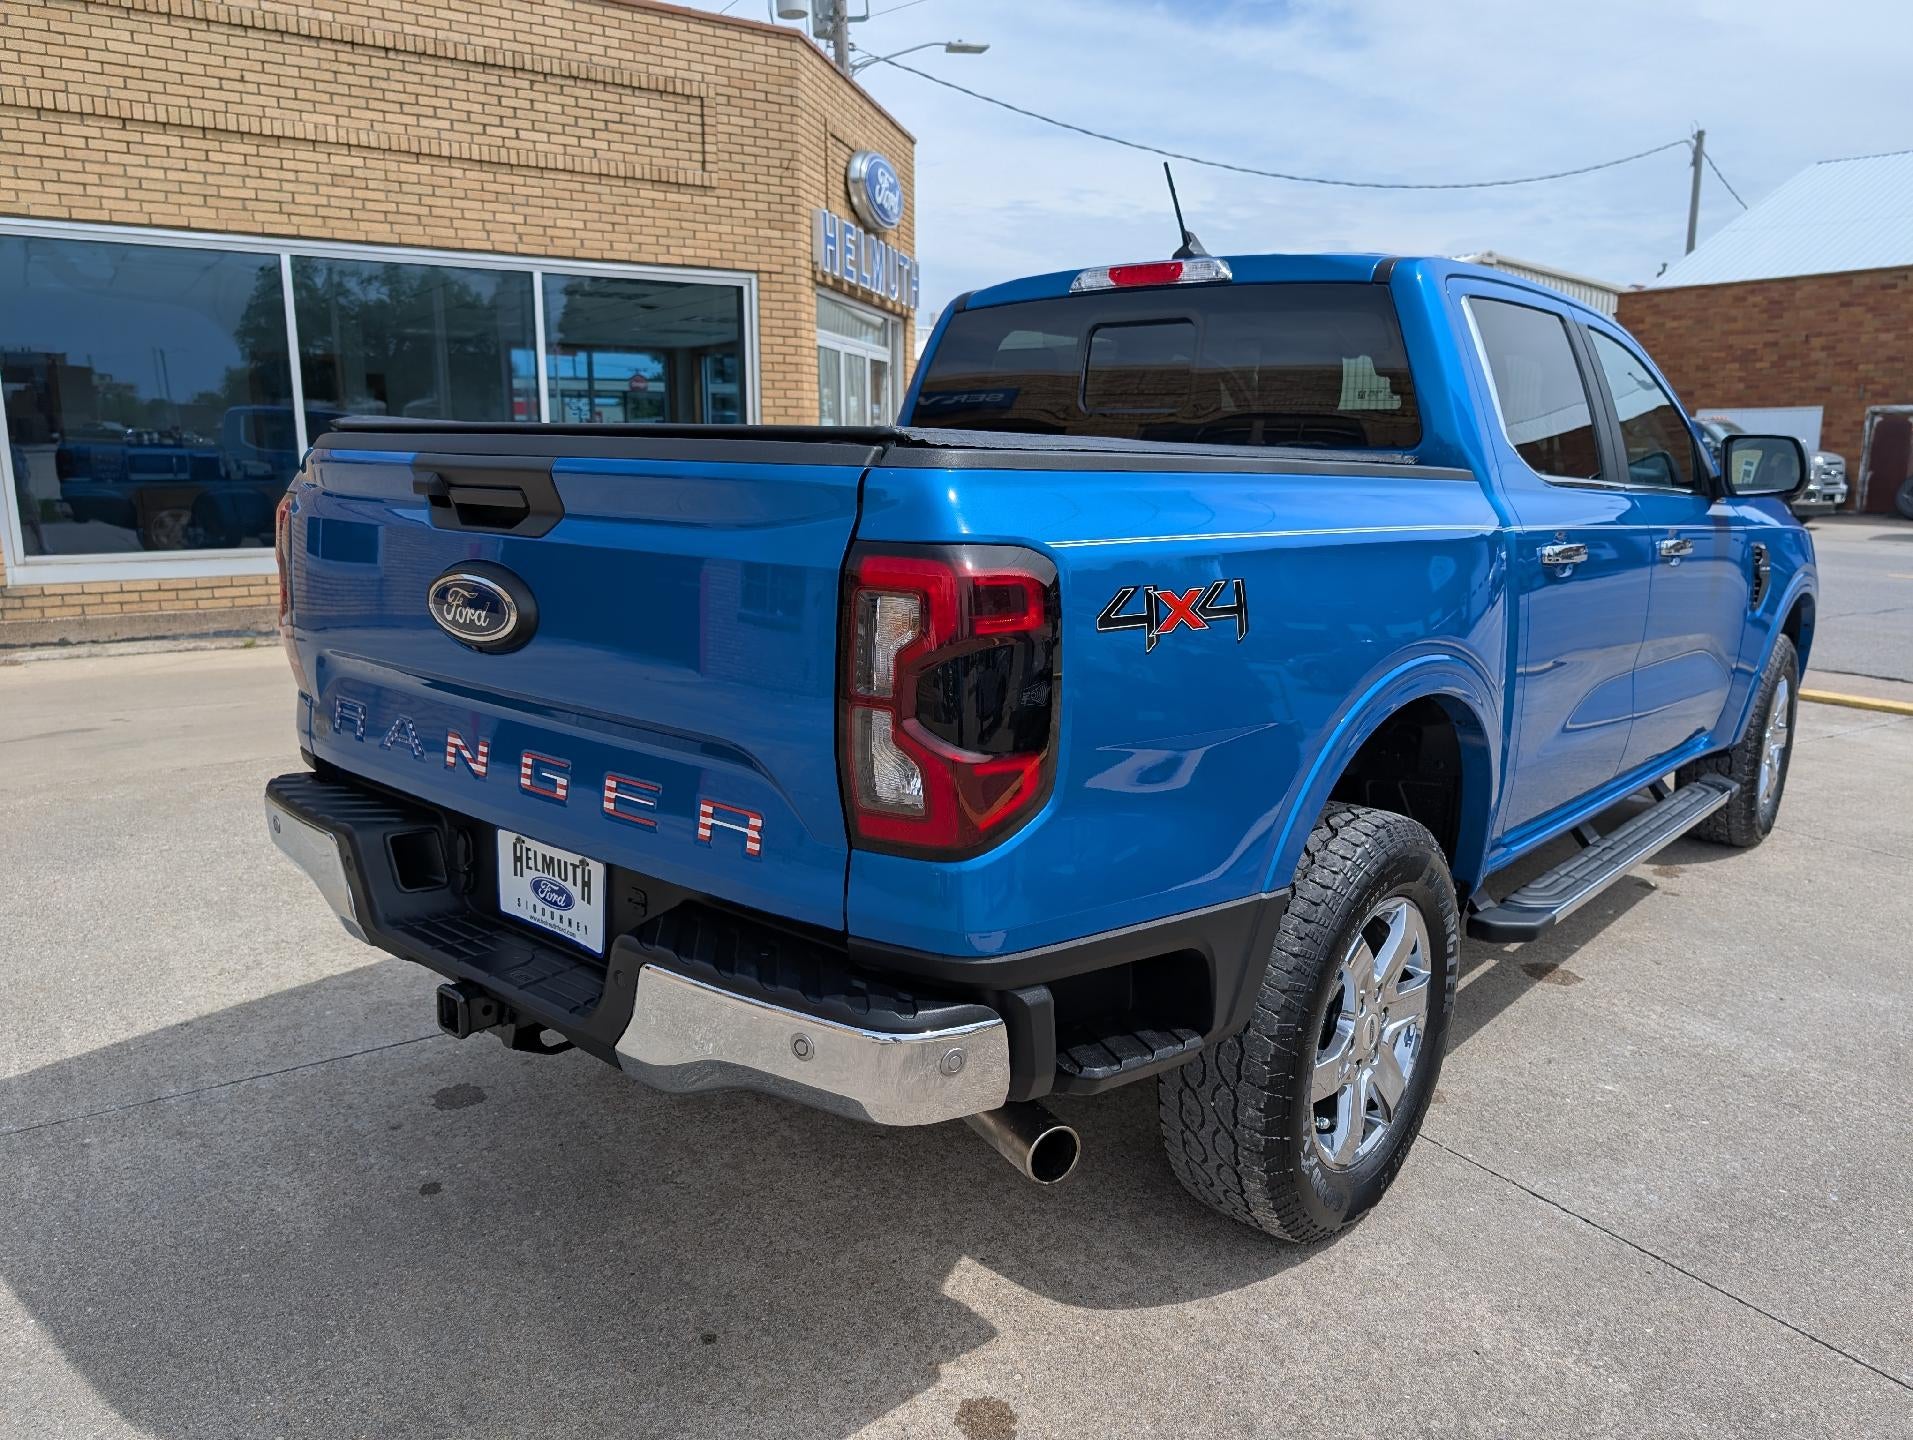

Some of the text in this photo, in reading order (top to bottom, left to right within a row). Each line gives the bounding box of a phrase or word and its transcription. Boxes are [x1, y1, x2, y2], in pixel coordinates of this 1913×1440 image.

[875, 167, 900, 215] Ford
[820, 208, 920, 309] HELMUTH
[443, 587, 490, 627] Ford
[333, 695, 763, 857] RANGER
[512, 837, 592, 906] HELMUTH
[538, 880, 568, 907] Ford
